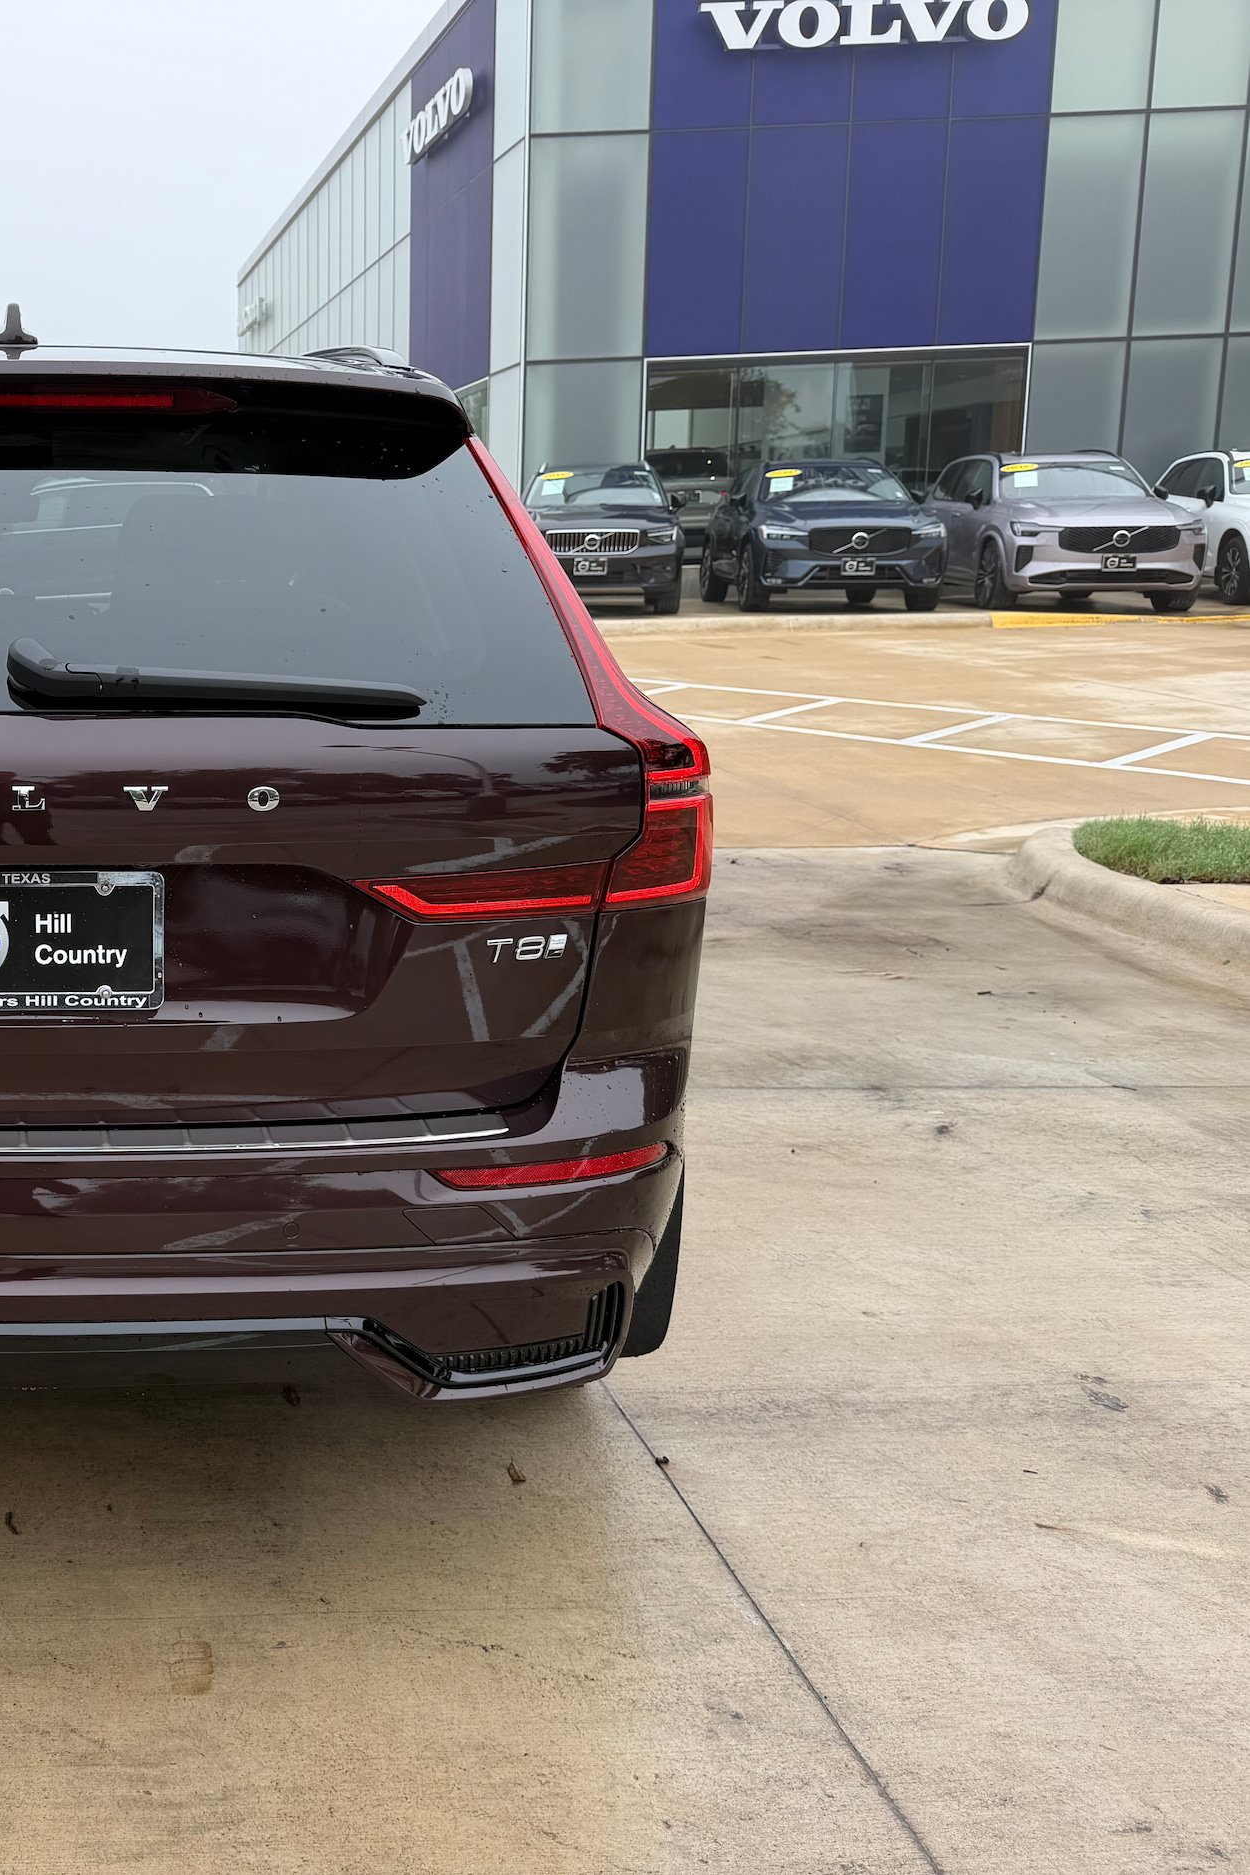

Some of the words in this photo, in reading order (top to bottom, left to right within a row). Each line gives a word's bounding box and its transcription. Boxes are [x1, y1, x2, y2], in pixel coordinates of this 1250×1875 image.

[699, 0, 1029, 50] VOLVO
[401, 68, 472, 164] VOLVO
[2, 873, 51, 885] TEXAS
[35, 914, 72, 934] Hill
[34, 945, 128, 968] Country
[25, 994, 58, 1007] Hill
[64, 994, 148, 1009] Country
